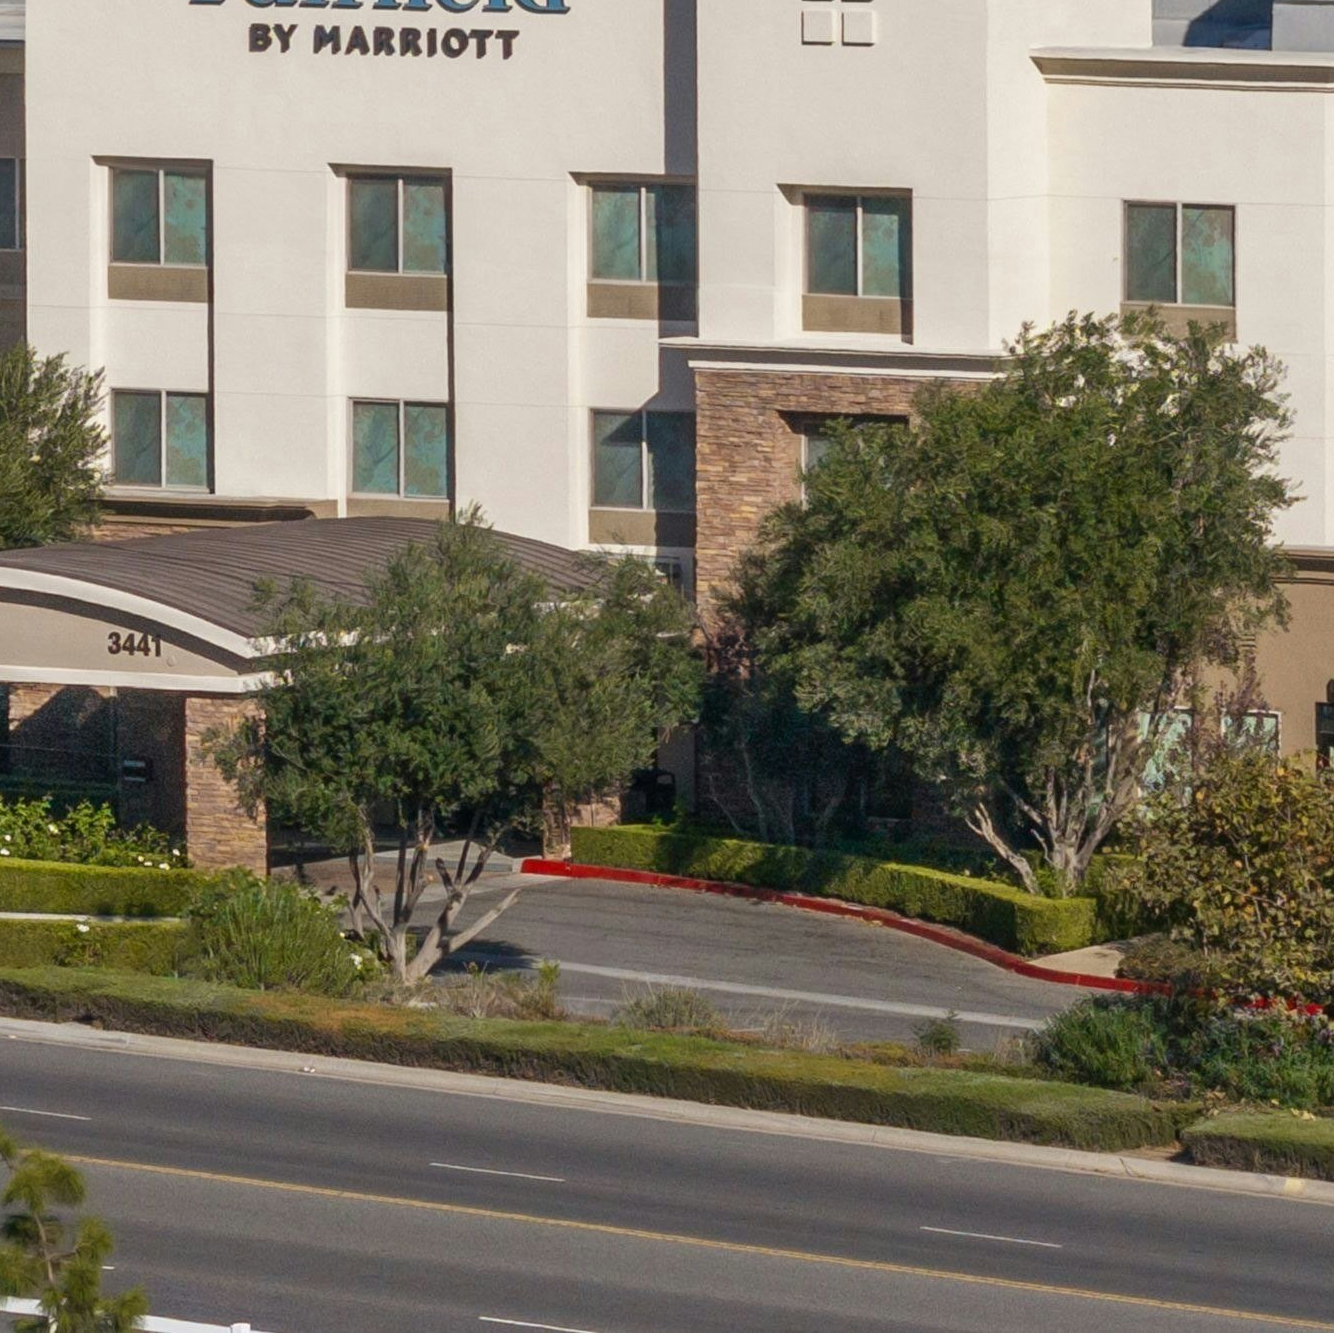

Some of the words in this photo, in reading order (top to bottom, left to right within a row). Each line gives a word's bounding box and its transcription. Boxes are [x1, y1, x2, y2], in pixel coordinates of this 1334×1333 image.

[248, 23, 298, 54] BY
[313, 24, 520, 60] MARRIOTT
[107, 631, 162, 657] 3441
